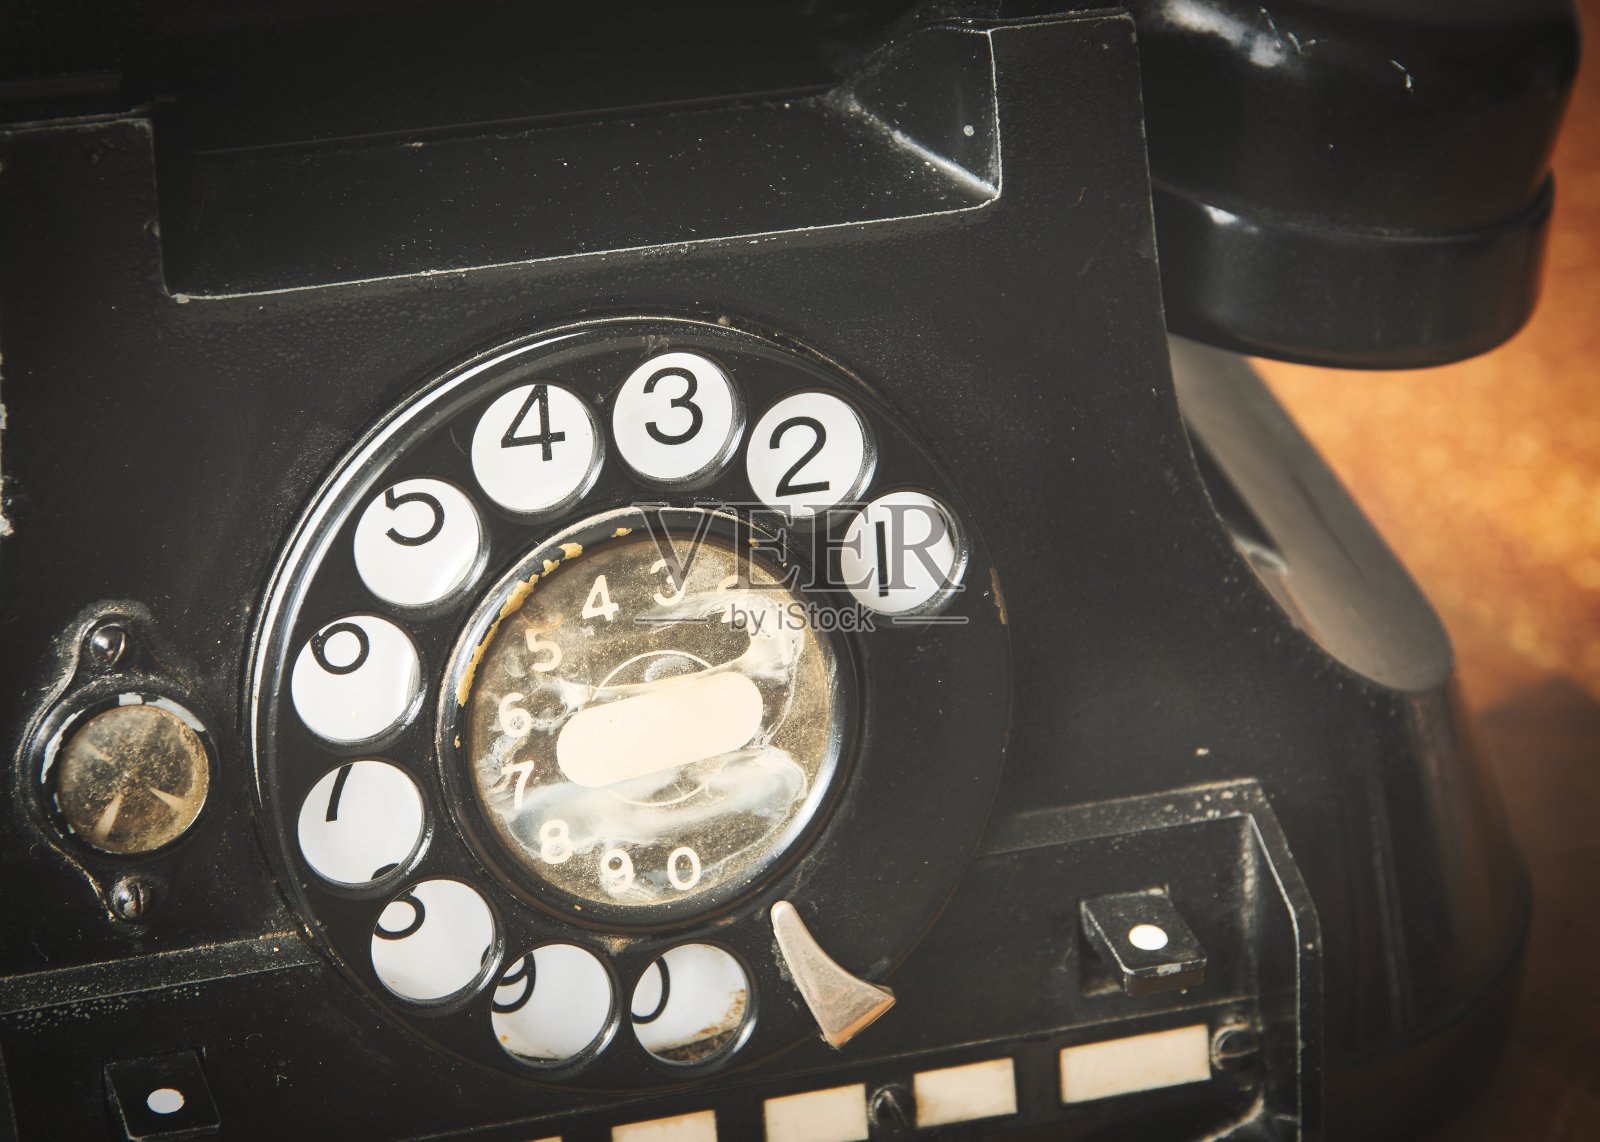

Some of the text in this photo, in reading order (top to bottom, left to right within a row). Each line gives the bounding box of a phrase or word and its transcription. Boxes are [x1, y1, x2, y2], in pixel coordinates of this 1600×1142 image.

[501, 384, 566, 461] 4
[643, 367, 704, 445] 3
[769, 416, 830, 497] 2
[384, 487, 445, 547] 5
[875, 521, 889, 597] 1
[582, 574, 619, 621] 4
[524, 628, 562, 672] 5
[499, 692, 532, 737] 6
[501, 760, 534, 809] 7
[540, 818, 573, 864] 8
[600, 848, 634, 892] 9
[667, 846, 701, 891] 0
